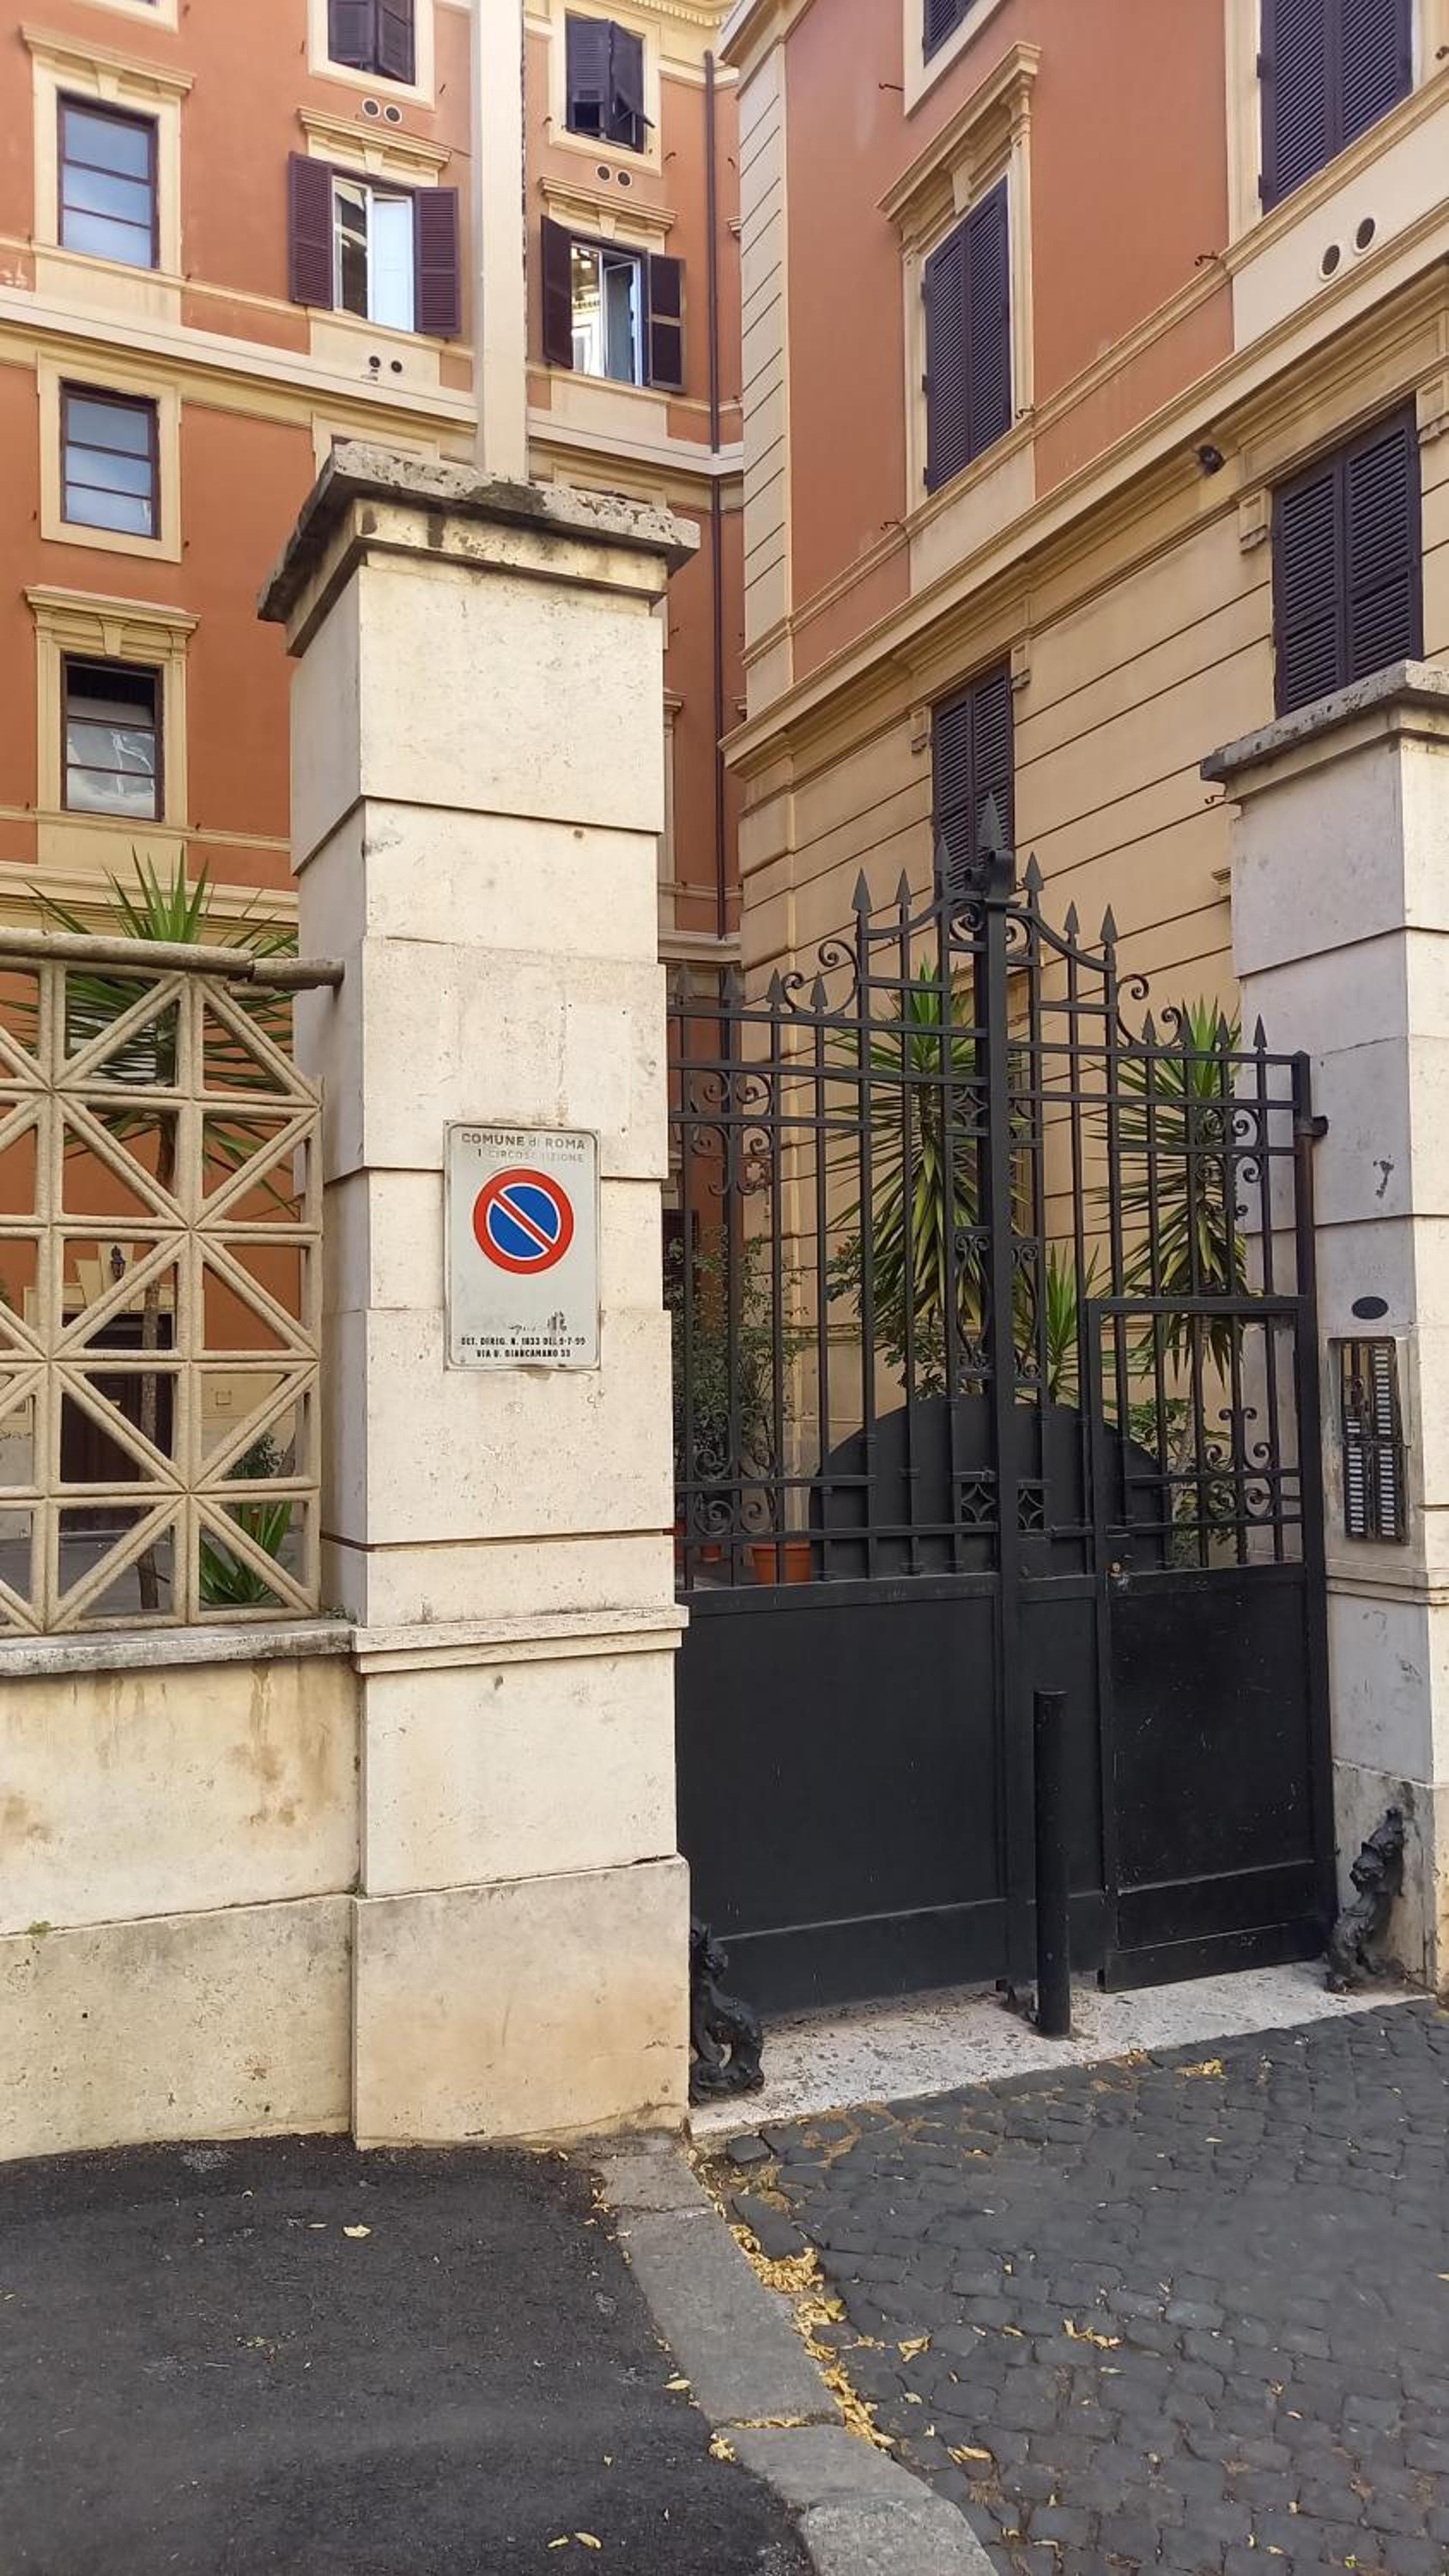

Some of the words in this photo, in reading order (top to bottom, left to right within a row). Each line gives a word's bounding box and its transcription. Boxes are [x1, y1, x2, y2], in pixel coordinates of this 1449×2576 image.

[461, 1133, 524, 1146] COMUNE
[545, 1137, 585, 1150] ROMA
[543, 1336, 557, 1346] DEL
[476, 1349, 491, 1358] VIA
